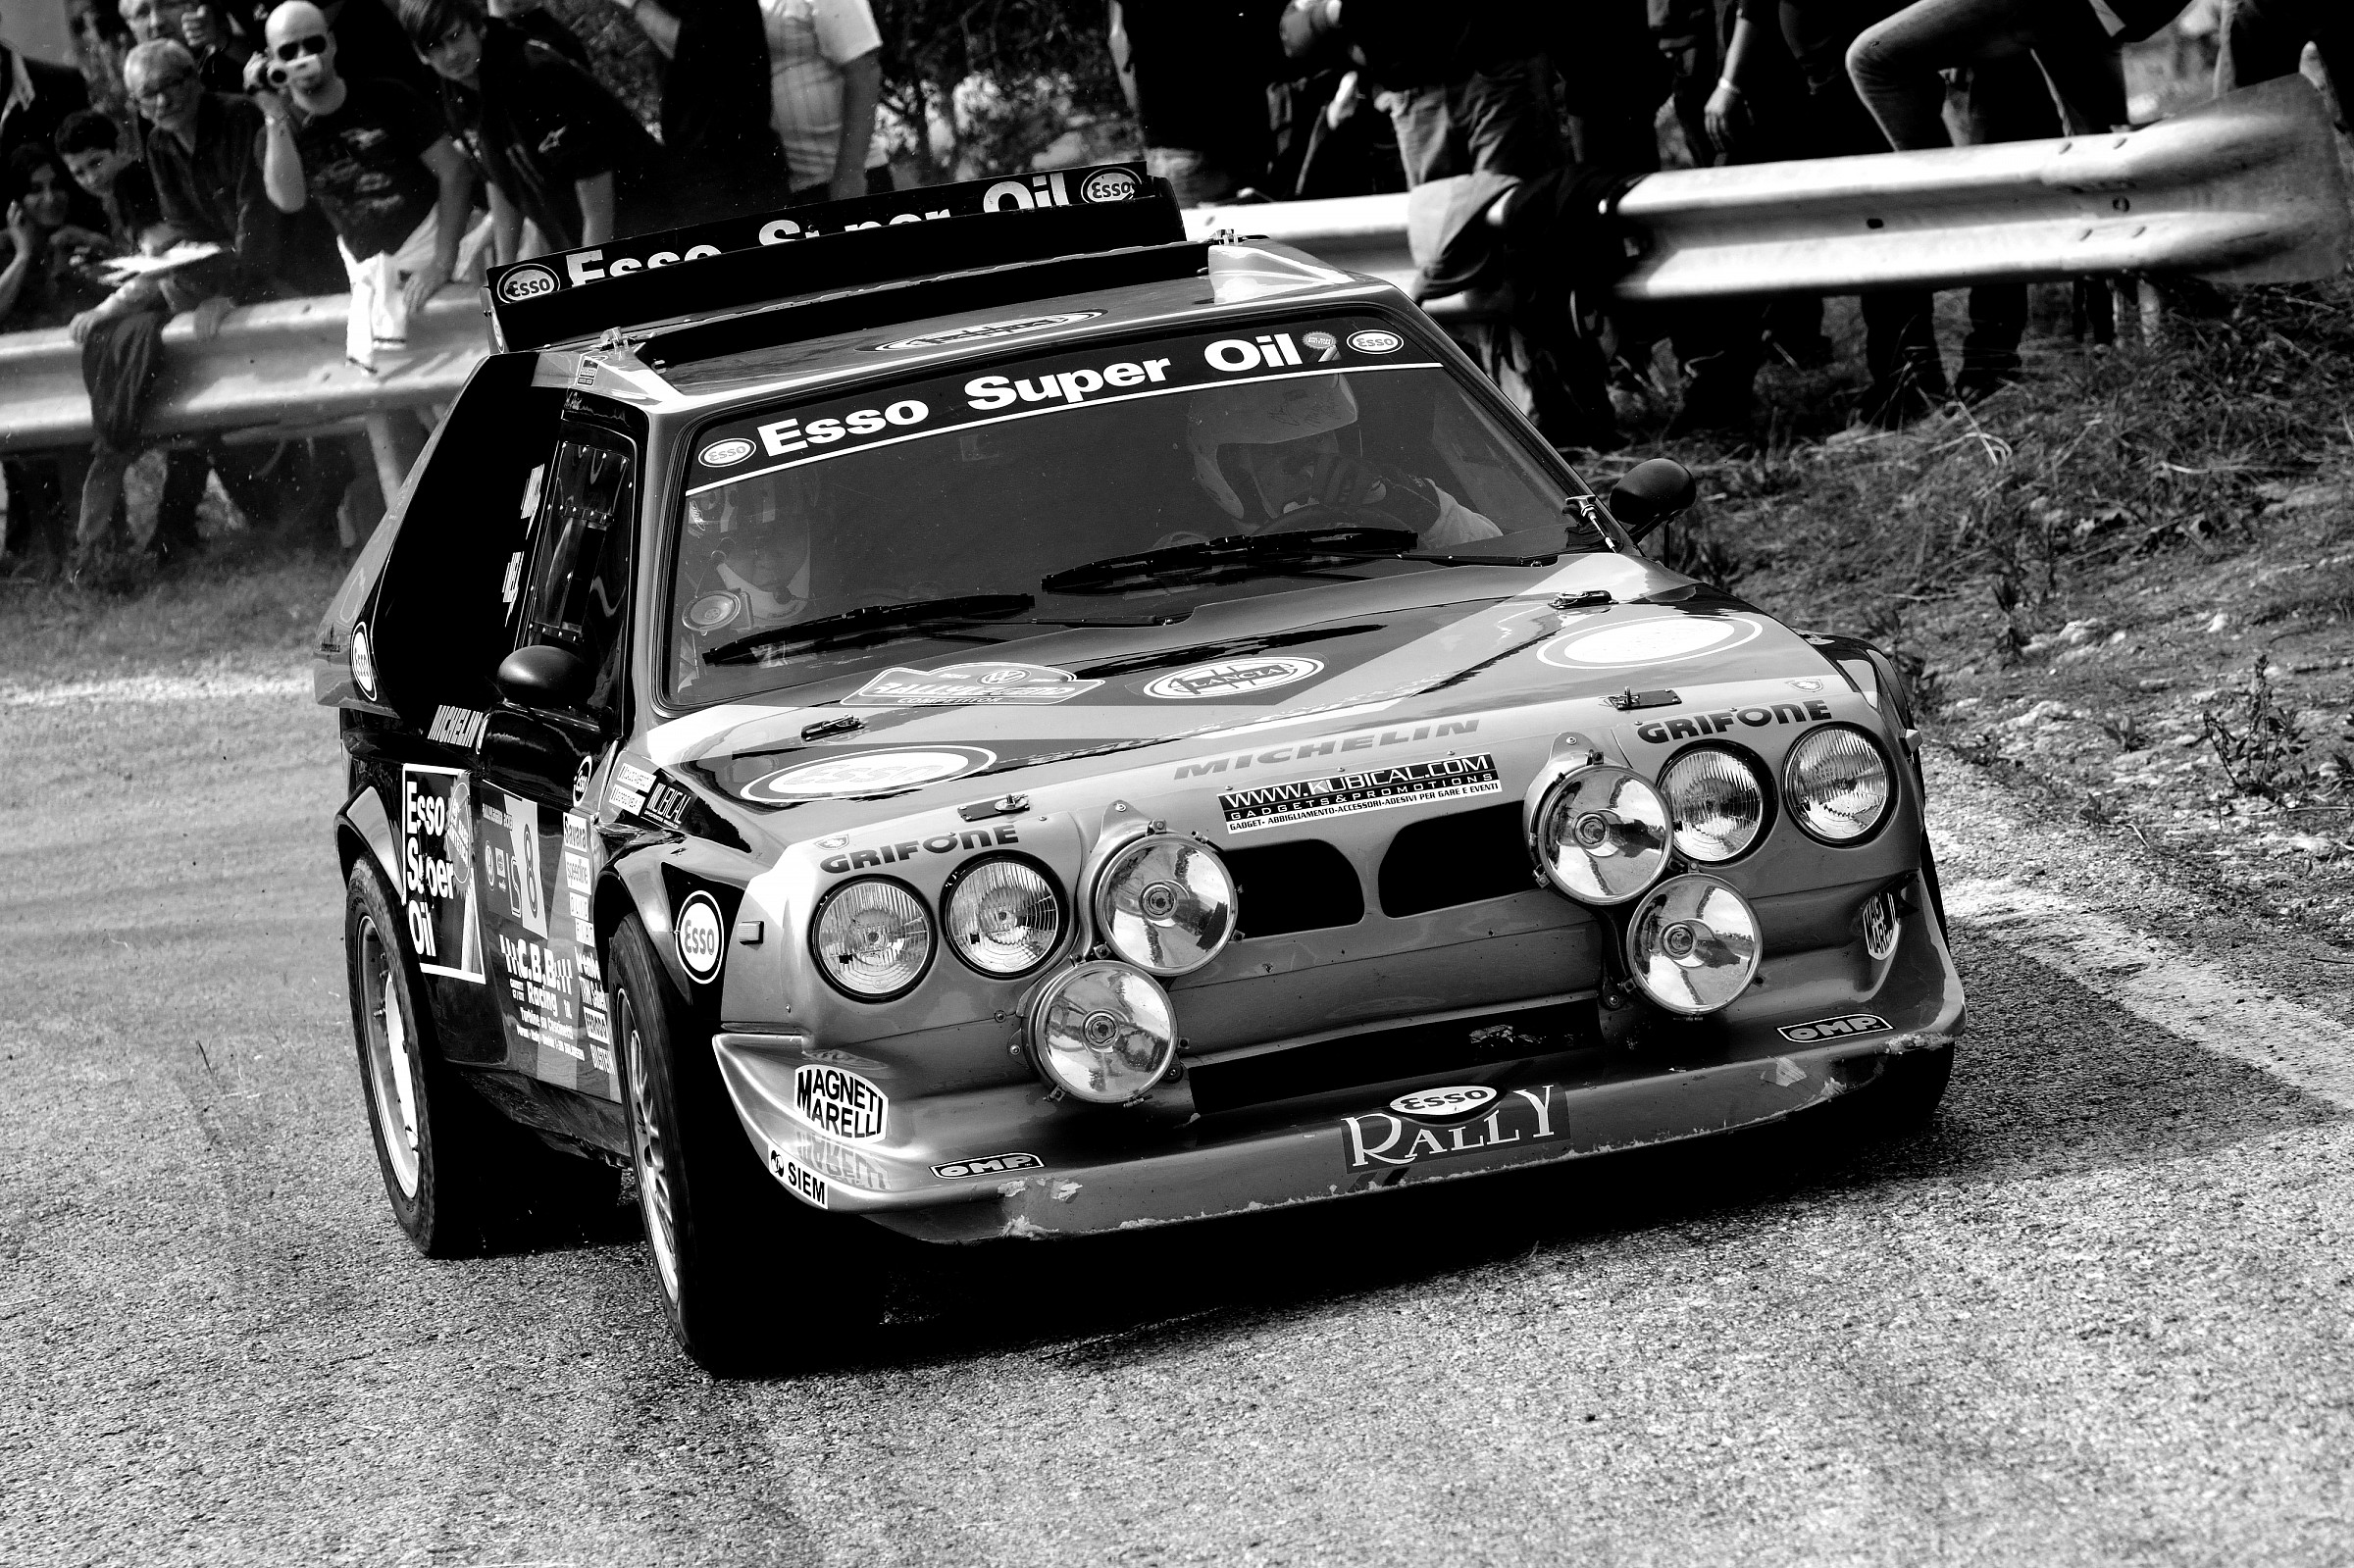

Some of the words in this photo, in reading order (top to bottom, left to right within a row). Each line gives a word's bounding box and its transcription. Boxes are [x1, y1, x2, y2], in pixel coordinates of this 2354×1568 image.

[1356, 337, 1394, 347] Esso
[757, 400, 929, 457] Esso
[964, 357, 1171, 410] Super
[1204, 333, 1303, 373] Oil
[708, 445, 745, 462] Esso
[1190, 668, 1280, 687] LANCIA
[428, 705, 484, 747] MICHELIN
[1637, 699, 1832, 744] GRIFONE
[1173, 720, 1480, 780] MICHELIN
[783, 764, 945, 785] Esso
[1225, 755, 1489, 808] WWW.KUBICAL.COM
[1420, 791, 1436, 801] PER
[1438, 787, 1460, 797] GARE
[1471, 783, 1499, 793] EVENTI
[406, 781, 445, 836] Esso
[819, 825, 1020, 874] GRIFONE
[408, 899, 437, 957] Oil
[684, 919, 715, 956] Esso
[527, 980, 559, 1018] Racing
[1788, 1017, 1877, 1039] OMP
[797, 1069, 883, 1116] MAGNETI
[1400, 1089, 1488, 1111] Esso
[797, 1096, 883, 1139] MARELLI
[1341, 1085, 1554, 1167] RALLY
[788, 1161, 826, 1205] SIEM
[940, 1156, 1032, 1177] OMP
